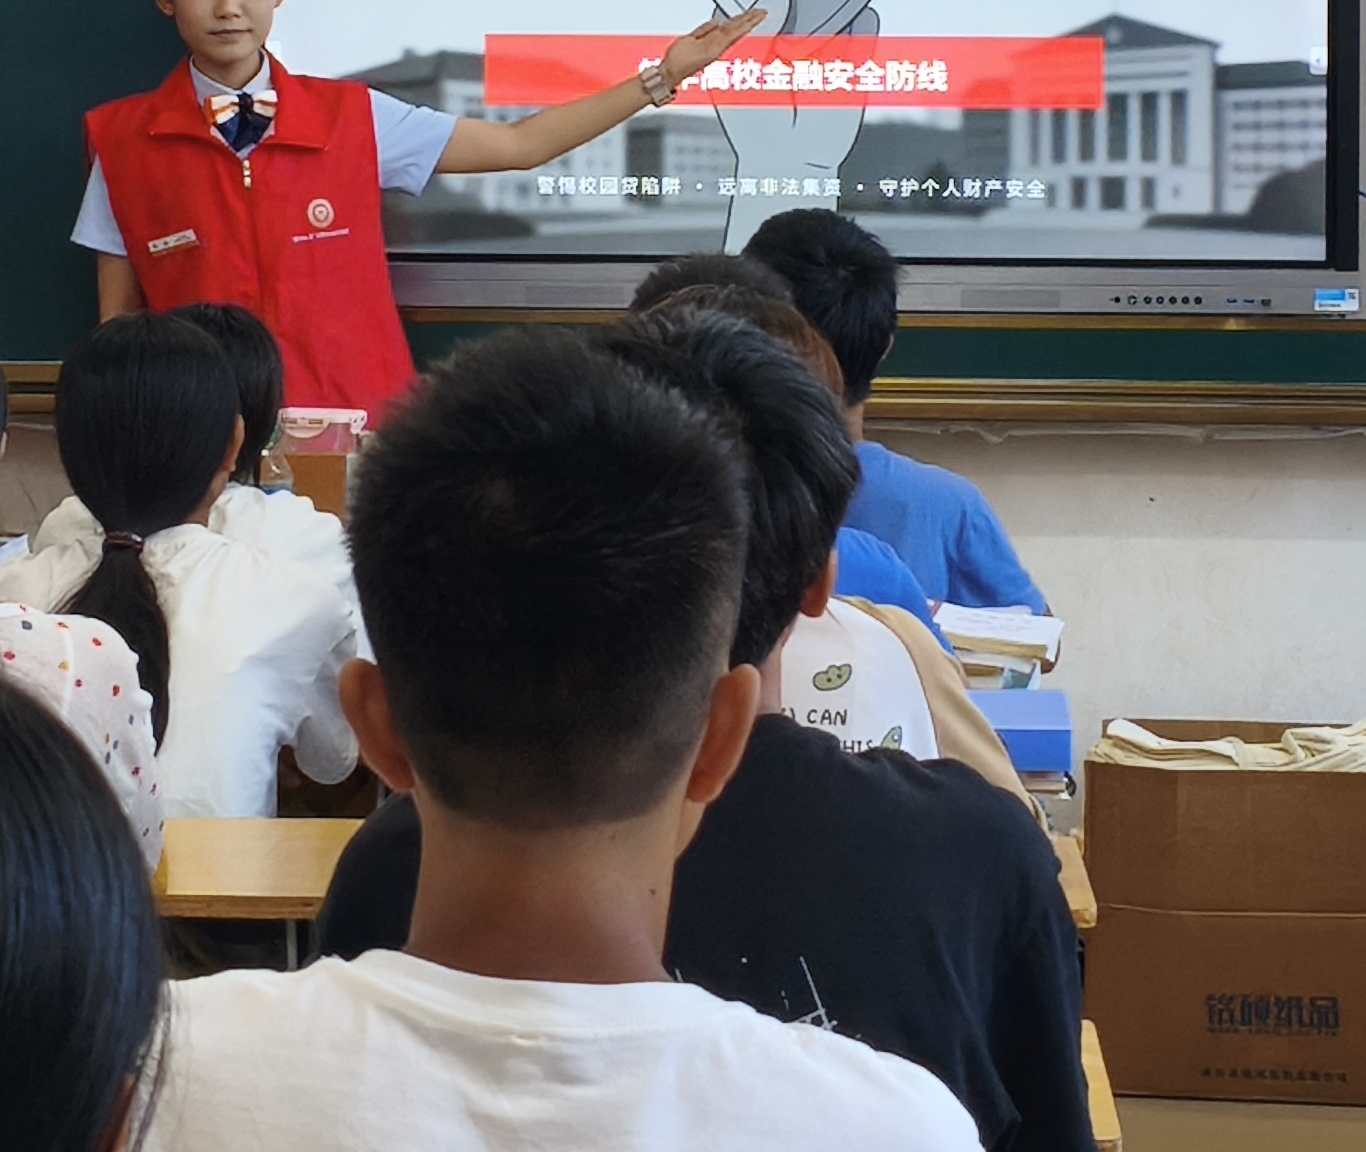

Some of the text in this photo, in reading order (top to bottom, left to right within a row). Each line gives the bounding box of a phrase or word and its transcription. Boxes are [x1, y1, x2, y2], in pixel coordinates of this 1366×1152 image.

[638, 57, 949, 93] 高校金融安全防线
[537, 176, 1046, 198] 警惕校园贷陷阱 远离非法集资 守护个人财产安全
[807, 709, 847, 726] CAN
